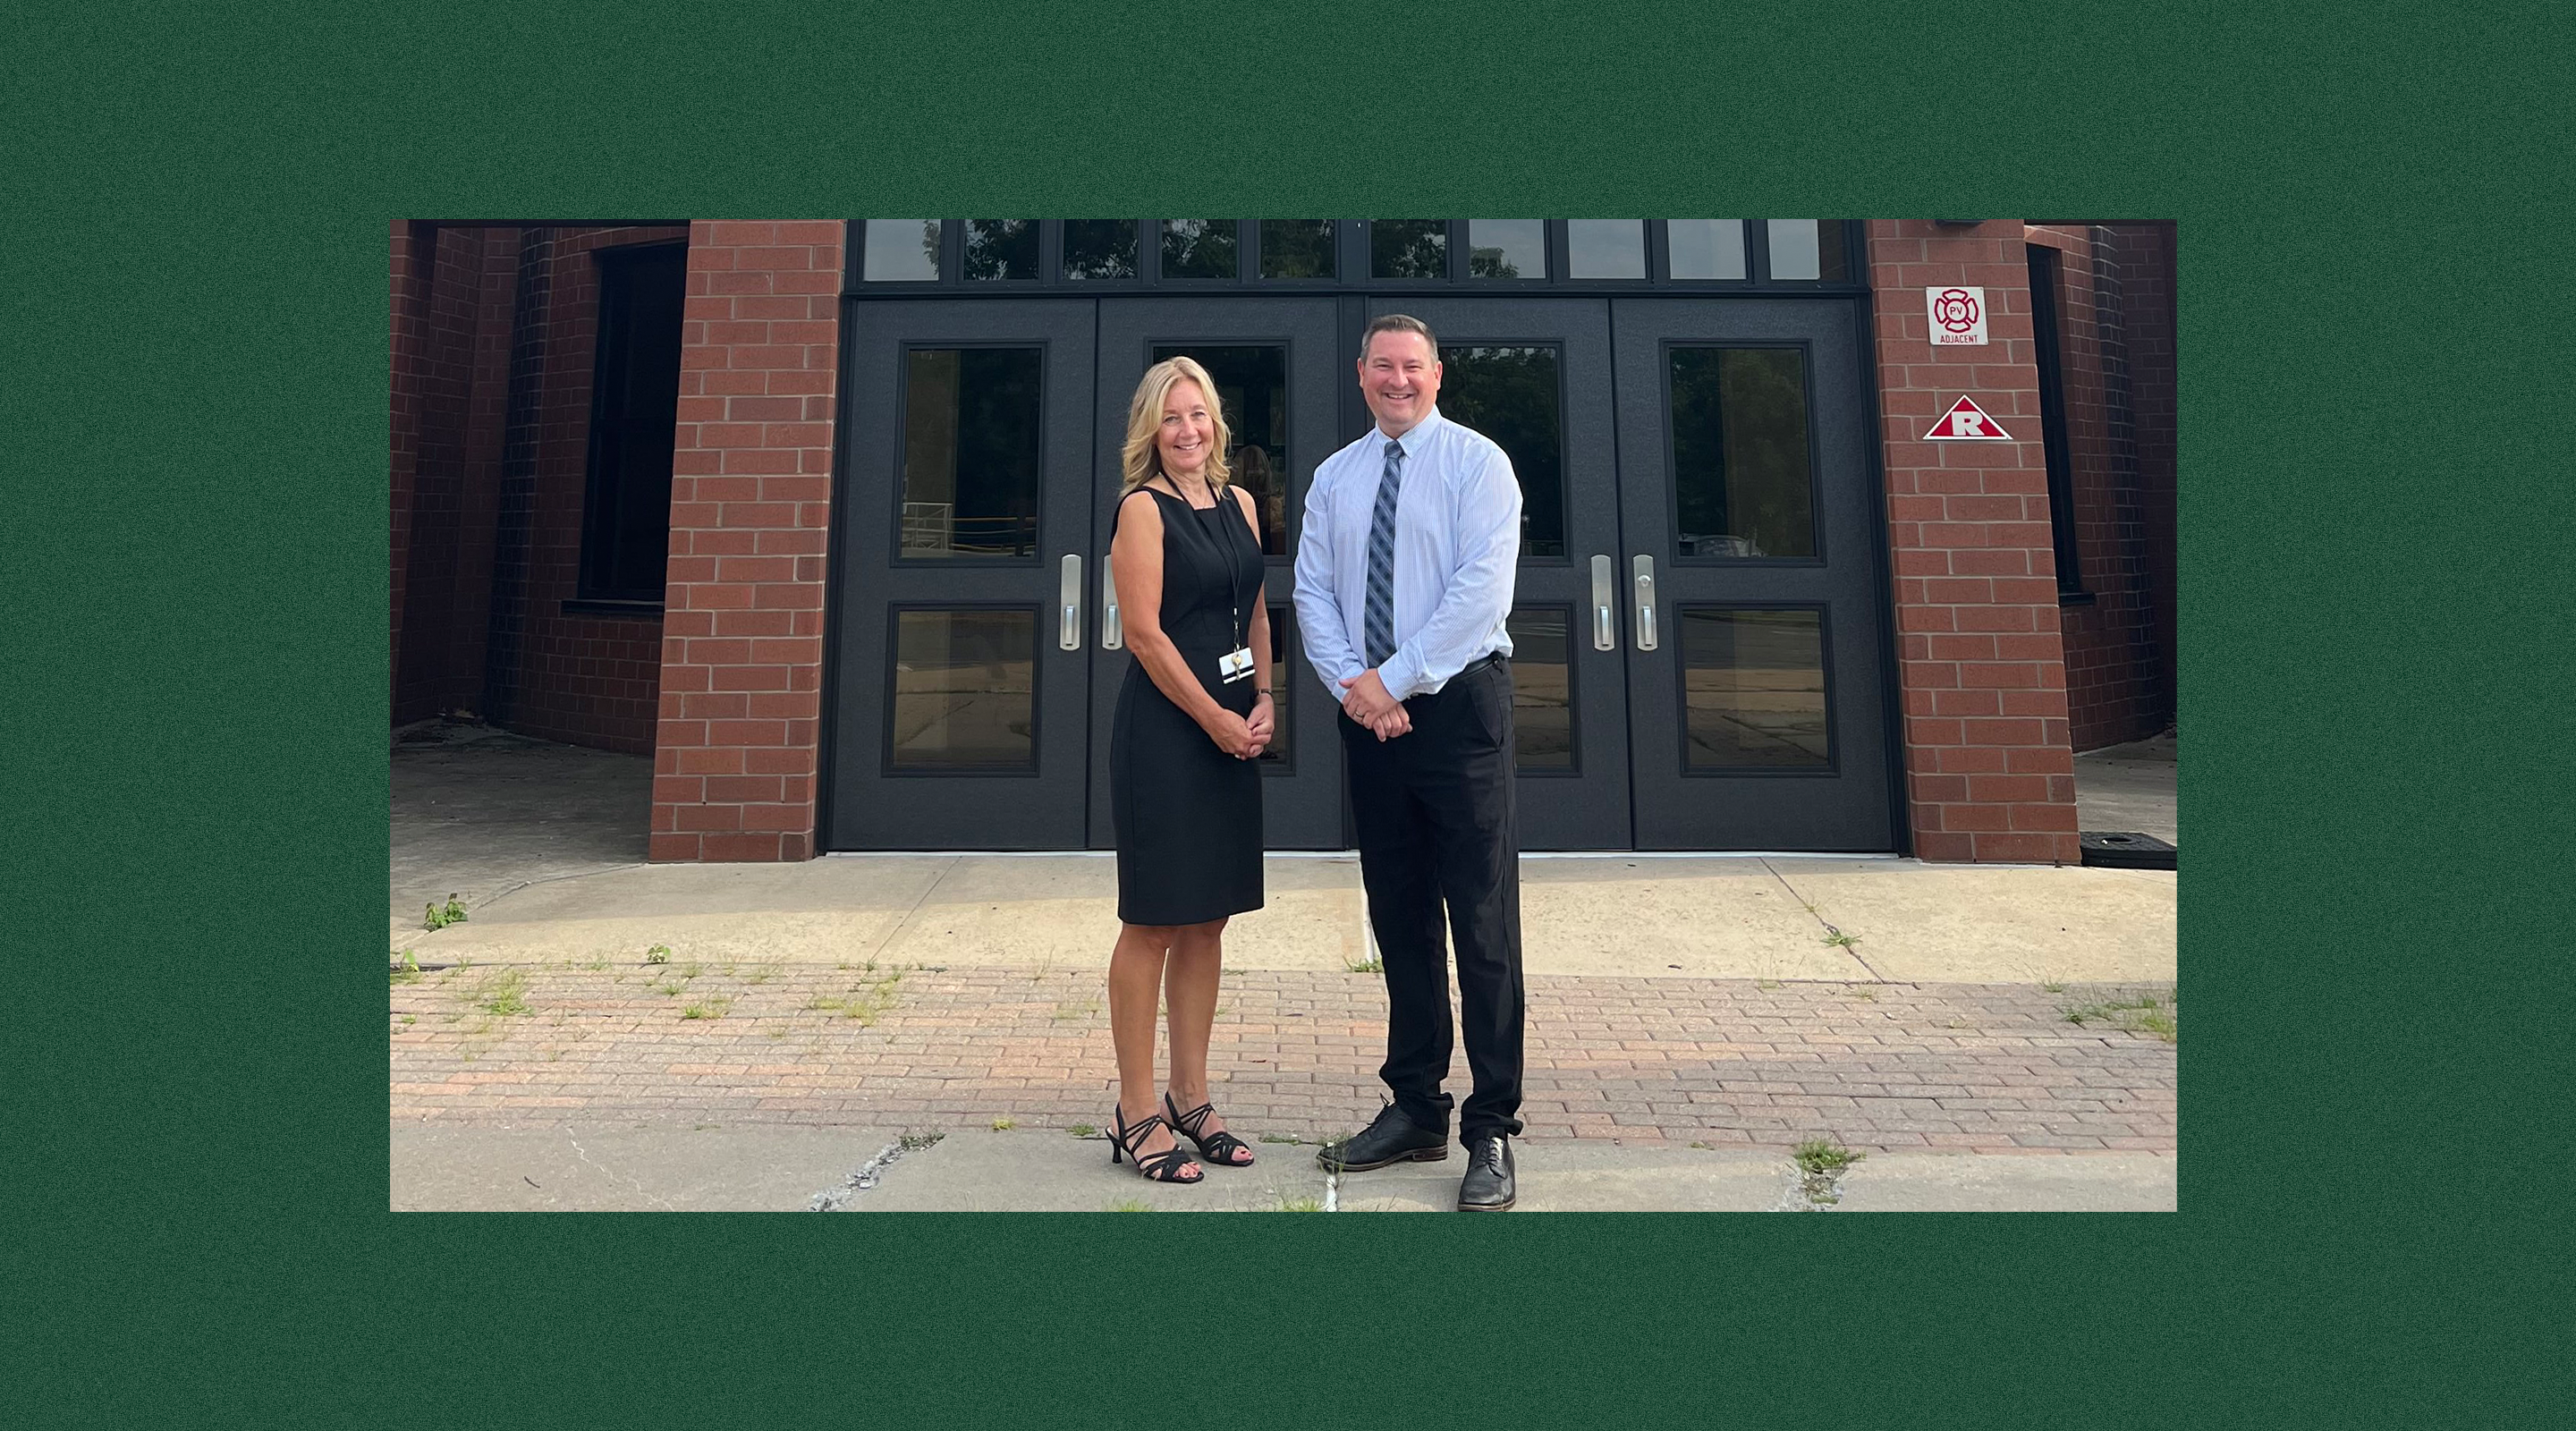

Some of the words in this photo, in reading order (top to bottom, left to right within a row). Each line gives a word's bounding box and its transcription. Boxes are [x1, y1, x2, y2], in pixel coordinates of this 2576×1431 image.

[1950, 307, 1962, 315] PV
[1940, 334, 1978, 343] ADJACENT
[1951, 411, 1985, 436] R
